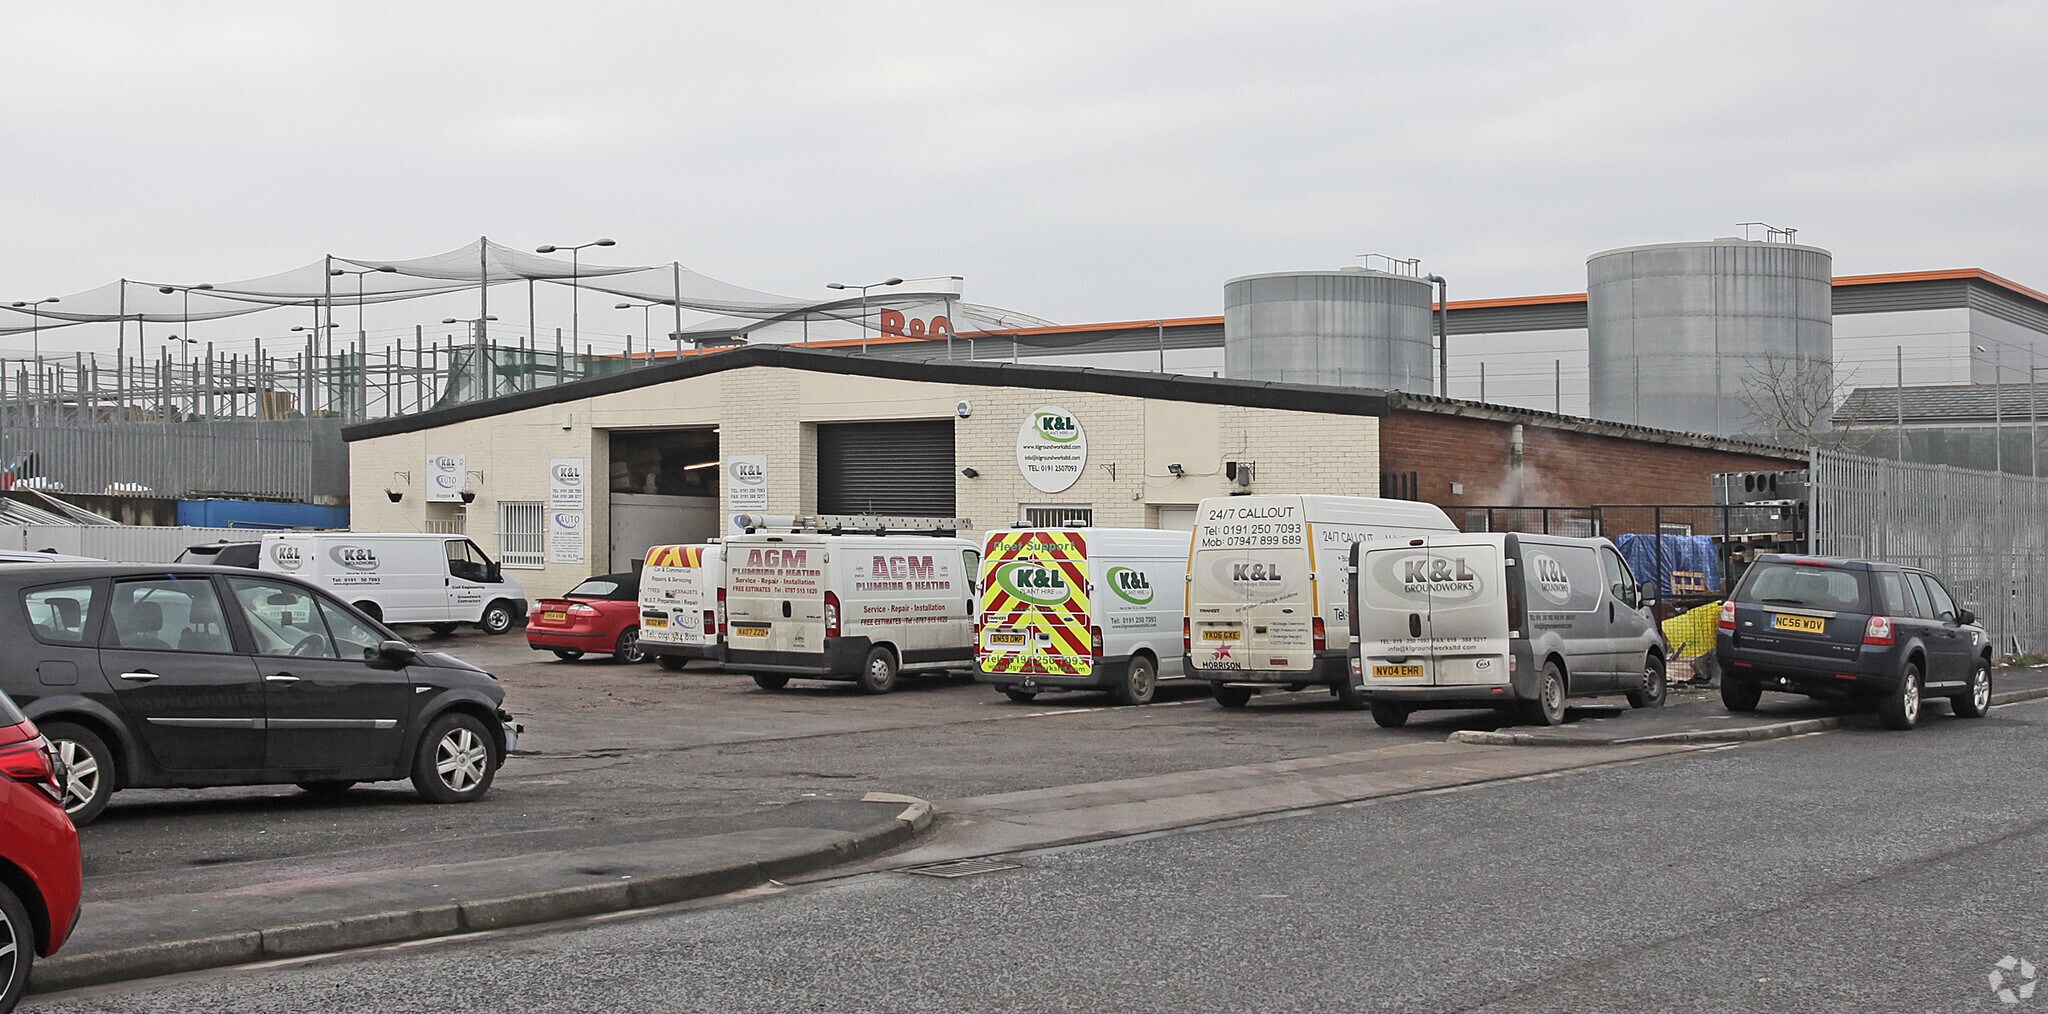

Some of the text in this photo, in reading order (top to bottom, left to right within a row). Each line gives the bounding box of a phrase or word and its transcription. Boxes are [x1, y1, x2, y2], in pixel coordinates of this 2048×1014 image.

[1043, 416, 1074, 430] K&L
[560, 468, 579, 477] K&L
[740, 465, 762, 475] K&L
[1209, 507, 1294, 520] 24/7 CALLOUT
[1204, 524, 1301, 535] Tel: 0191 250 7093
[1202, 535, 1301, 547] Mob: 07947 899 689
[993, 542, 1075, 553] Fleet Support
[279, 548, 300, 559] K&L
[344, 549, 376, 560] K&L
[747, 549, 806, 568] AGM
[872, 556, 934, 580] AGM
[1234, 564, 1281, 581] K&L
[1405, 558, 1473, 583] K&L
[1538, 560, 1567, 582] K&L
[1017, 569, 1064, 588] K&L
[1120, 572, 1149, 589] K&L
[856, 582, 903, 591] PLUMBING
[915, 581, 950, 590] HEATING
[1405, 582, 1474, 593] GROUNDWORKS
[891, 605, 909, 613] Repair
[914, 604, 945, 612] Installation
[1776, 618, 1822, 629] NC56 WDV
[658, 632, 670, 641] 0191
[672, 632, 683, 642] 384
[1037, 656, 1055, 664] 250
[1060, 656, 1084, 665] 7093
[1376, 666, 1419, 675] NV04 EHR
